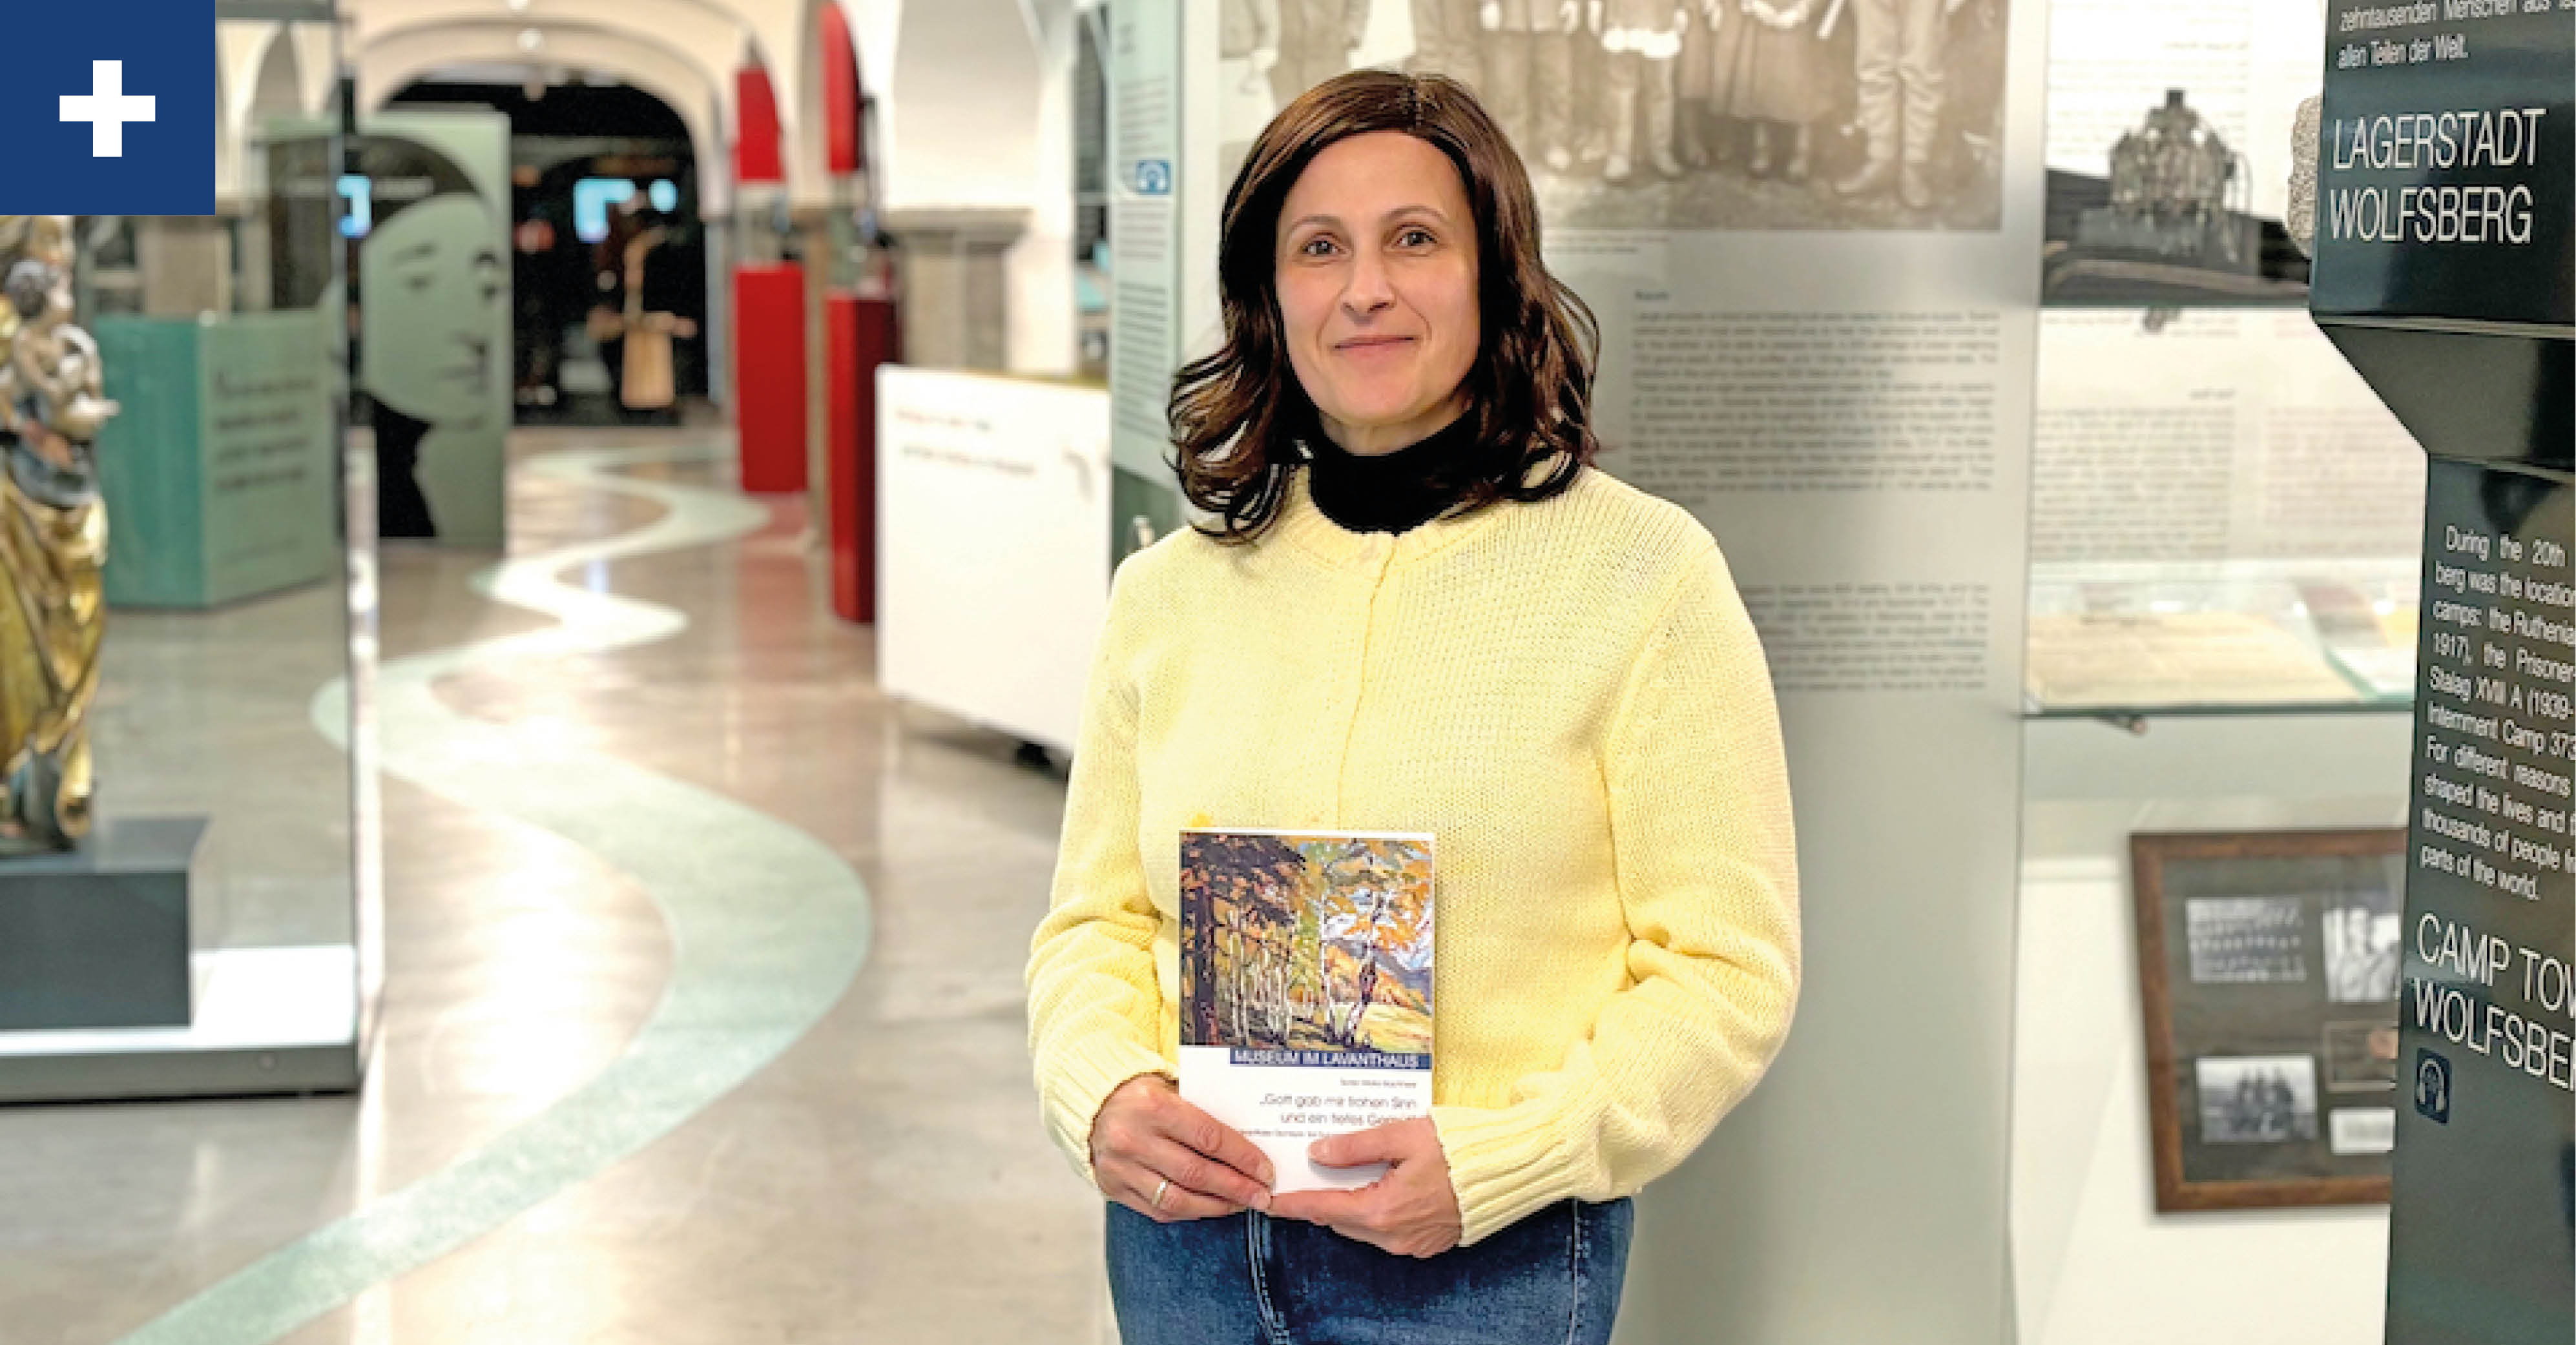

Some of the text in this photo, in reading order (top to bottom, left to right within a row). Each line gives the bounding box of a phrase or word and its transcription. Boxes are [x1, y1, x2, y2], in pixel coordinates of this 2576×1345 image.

[2338, 1, 2436, 31] zehntausenden
[2338, 34, 2469, 68] allen Teilen der Welt.
[2332, 108, 2548, 170] LAGERSTADT
[2329, 183, 2533, 244] WOLFSBERG
[2446, 525, 2566, 568] During the 20th
[2435, 560, 2575, 608] berg was the locatio
[2433, 601, 2482, 628] camps:
[2489, 606, 2511, 633] the
[2484, 641, 2507, 670] the
[2429, 666, 2471, 703] Stalag
[2509, 684, 2523, 710] A
[2427, 701, 2499, 741] Internment
[2502, 719, 2545, 755] Camp
[2426, 734, 2572, 798] For different reasons
[2424, 772, 2474, 807] shaped
[2476, 785, 2499, 815] the
[2502, 792, 2534, 825] lives
[2537, 805, 2566, 834] and
[2422, 807, 2491, 848] thousands
[2495, 828, 2510, 853] of
[2511, 837, 2562, 872] people
[2420, 845, 2540, 901] parts of the world.
[2416, 912, 2511, 987] CAMP
[1234, 1049, 1419, 1068] MUSEUM IM LAVANTHAUS
[1280, 1113, 1305, 1125] und
[1307, 1113, 1327, 1125] ein
